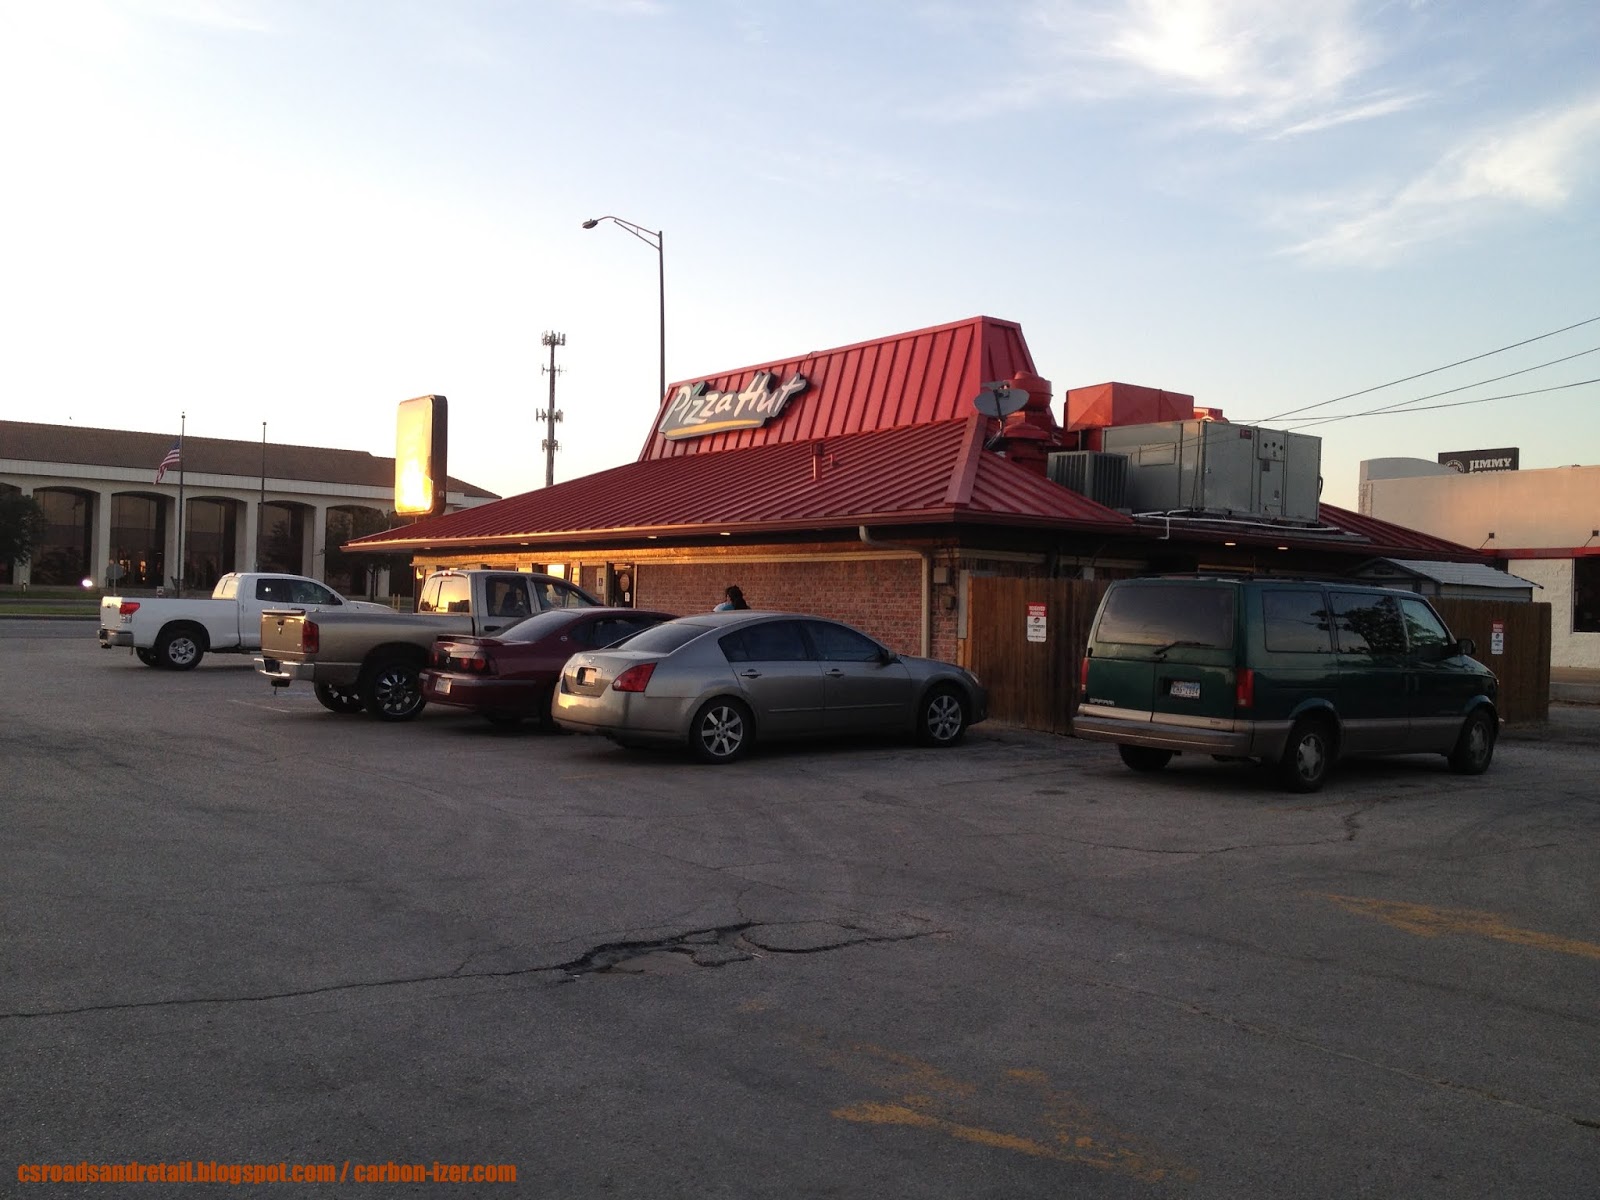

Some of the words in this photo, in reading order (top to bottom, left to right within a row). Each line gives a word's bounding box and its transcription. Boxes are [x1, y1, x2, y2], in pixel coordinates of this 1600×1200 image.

[659, 384, 732, 430] Pizza
[734, 374, 804, 417] Hut
[1469, 458, 1512, 471] JIMMY
